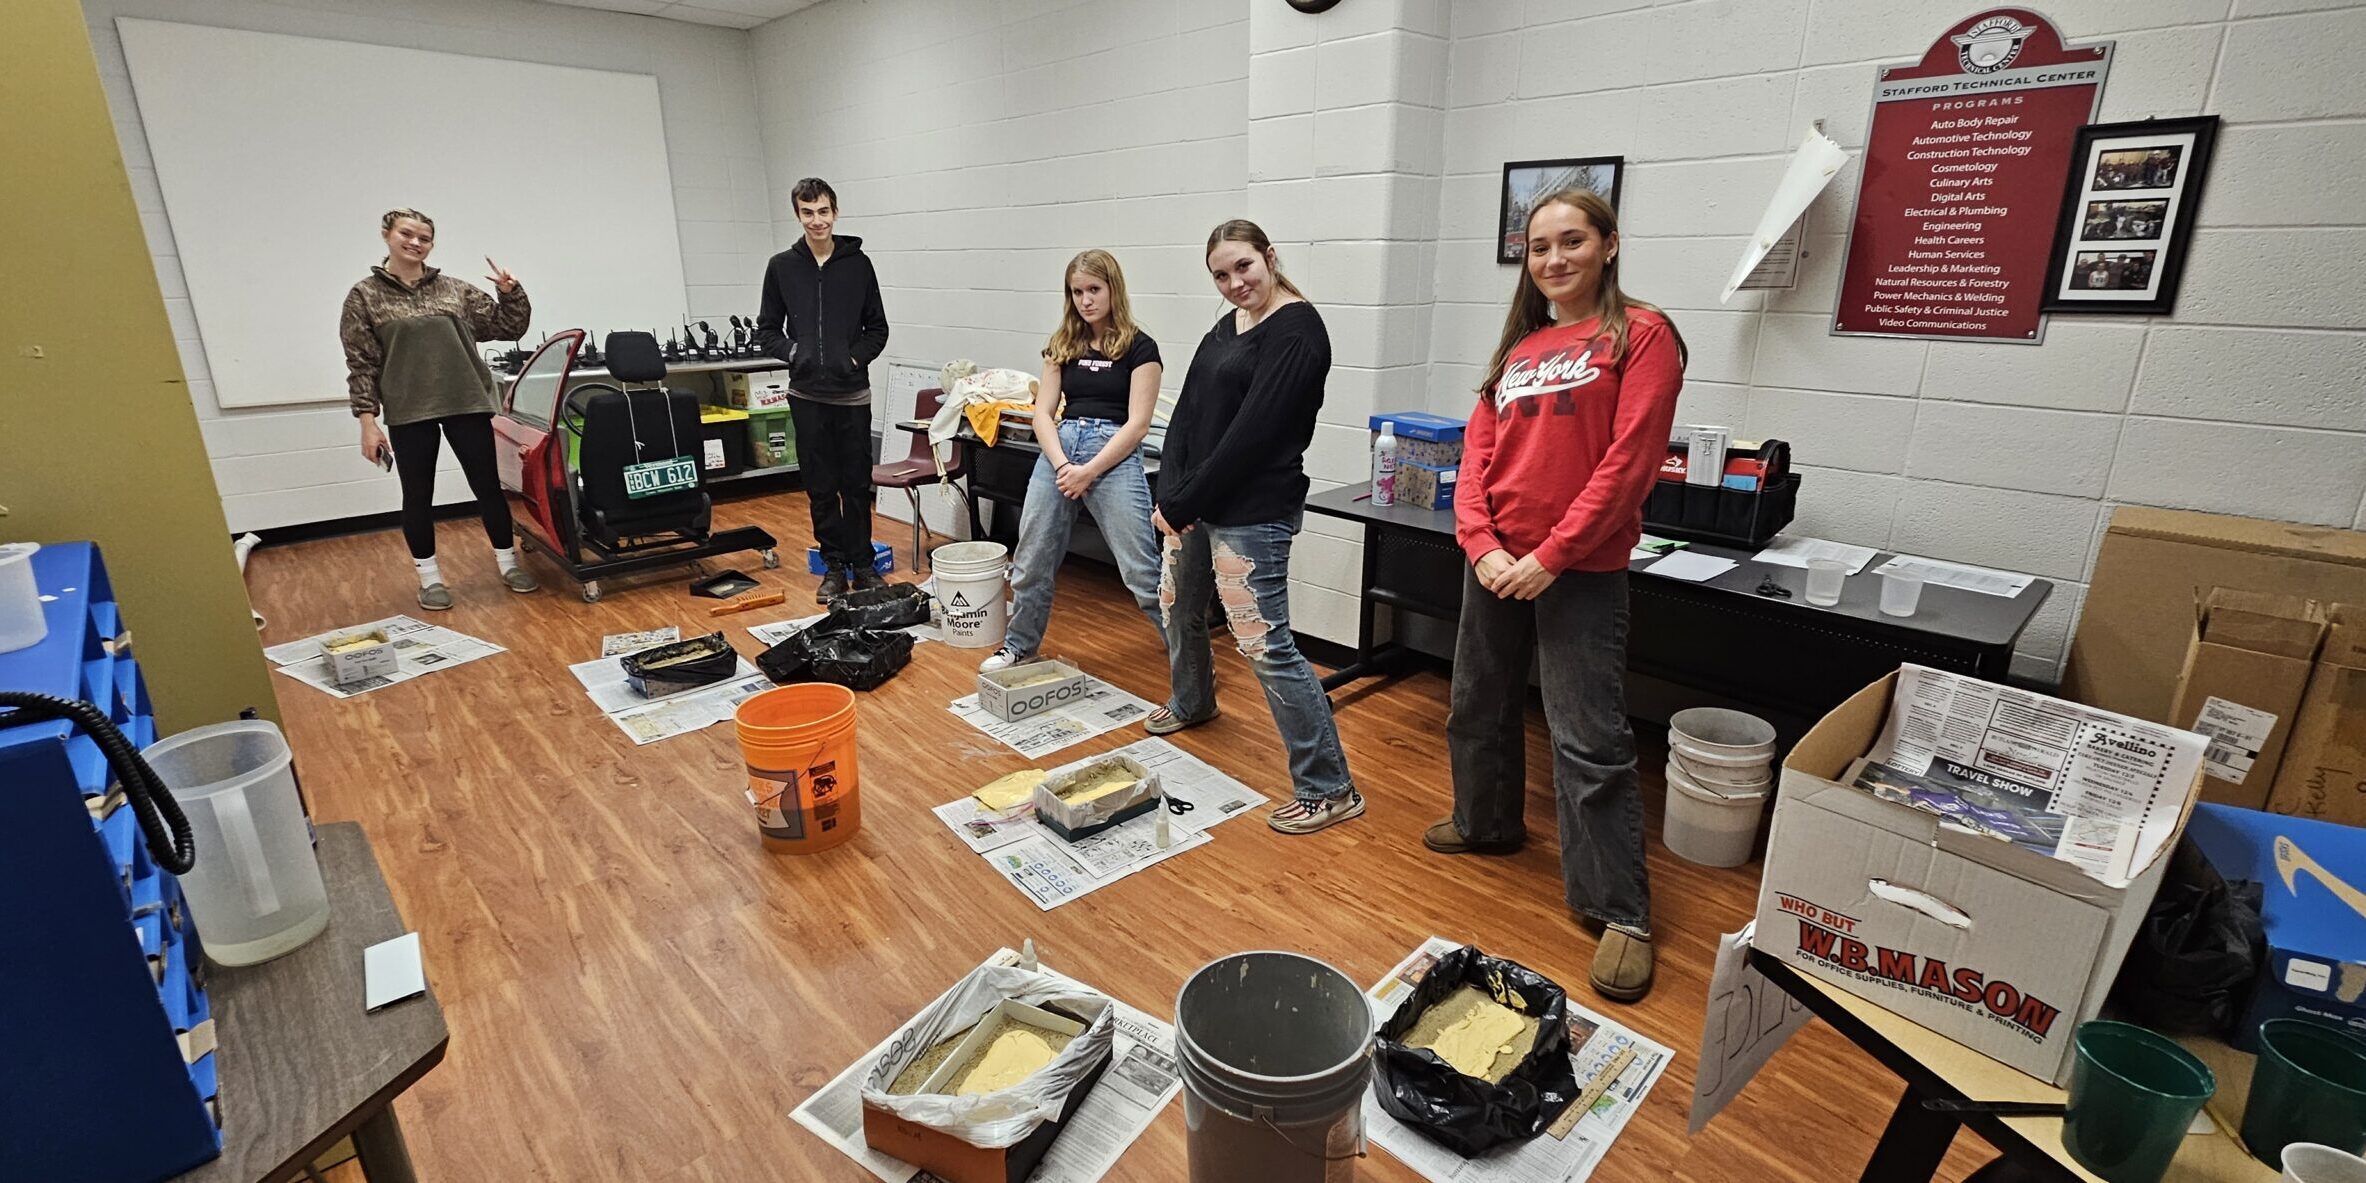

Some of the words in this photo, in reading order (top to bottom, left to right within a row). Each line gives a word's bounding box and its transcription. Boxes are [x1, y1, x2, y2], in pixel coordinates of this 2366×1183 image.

[1882, 84, 1949, 97] STAFFORD
[1953, 77, 2031, 91] TECHNICAL
[2036, 70, 2096, 83] CENTER
[1932, 96, 2024, 111] PROGRAMS
[1931, 119, 1955, 130] Auto
[1957, 117, 1983, 129] Body
[1985, 115, 2019, 127] Repair
[1912, 135, 1970, 146] Automotive
[1972, 129, 2033, 142] Technology
[1907, 150, 1970, 161] Construction
[1972, 145, 2032, 157] Technology
[1931, 162, 1998, 174] Cosmetology
[1930, 178, 1971, 188] Culinary
[1972, 176, 1993, 186] Arts
[1931, 192, 1963, 204] Digital
[1965, 192, 1986, 201] Arts
[1904, 207, 1948, 217] Electrical
[1949, 208, 1957, 216] &
[1958, 206, 2008, 217] Plumbing
[1922, 221, 1982, 232] Engineering
[1914, 236, 1946, 245] Health
[1948, 235, 1985, 245] Careers
[1908, 250, 1943, 259] Human
[1945, 250, 1985, 259] Services
[1888, 264, 1939, 274] Leadership
[1941, 264, 1949, 273] &
[1950, 264, 2001, 275] Marketing
[1875, 278, 1909, 287] Natural
[1910, 278, 1957, 287] Resources
[1959, 279, 1967, 287] &
[1968, 278, 2010, 289] Forestry
[1873, 291, 1902, 300] Power
[1903, 292, 1953, 301] Mechanics
[1954, 293, 1962, 301] &
[1963, 293, 2005, 304] Welding
[1864, 304, 1893, 314] Public
[1894, 305, 1922, 315] Safety
[1923, 306, 1931, 314] &
[1932, 306, 1973, 316] Criminal
[1974, 307, 2010, 317] Justice
[1878, 318, 1905, 327] Video
[1906, 319, 1987, 330] Communications
[1533, 350, 1600, 388] York
[667, 464, 694, 483] 612
[947, 617, 981, 629] Moore
[953, 629, 974, 637] Paints
[1011, 681, 1082, 715] OOFOS
[2089, 732, 2157, 758] Avellino
[1947, 763, 1990, 785] TRAVEL
[1991, 778, 2034, 798] SHOW
[1779, 896, 1817, 918] WHO
[1822, 910, 1856, 933] BUT
[1796, 949, 1815, 964] FOR
[1817, 958, 1853, 978] OFFICE
[1855, 972, 1908, 993] SUPPLIES,
[1910, 985, 1974, 1014] FURNITURE
[1975, 1008, 1985, 1017] &
[1987, 1011, 2044, 1045] PRINTING
[1113, 1016, 1160, 1043] RKETPLACE
